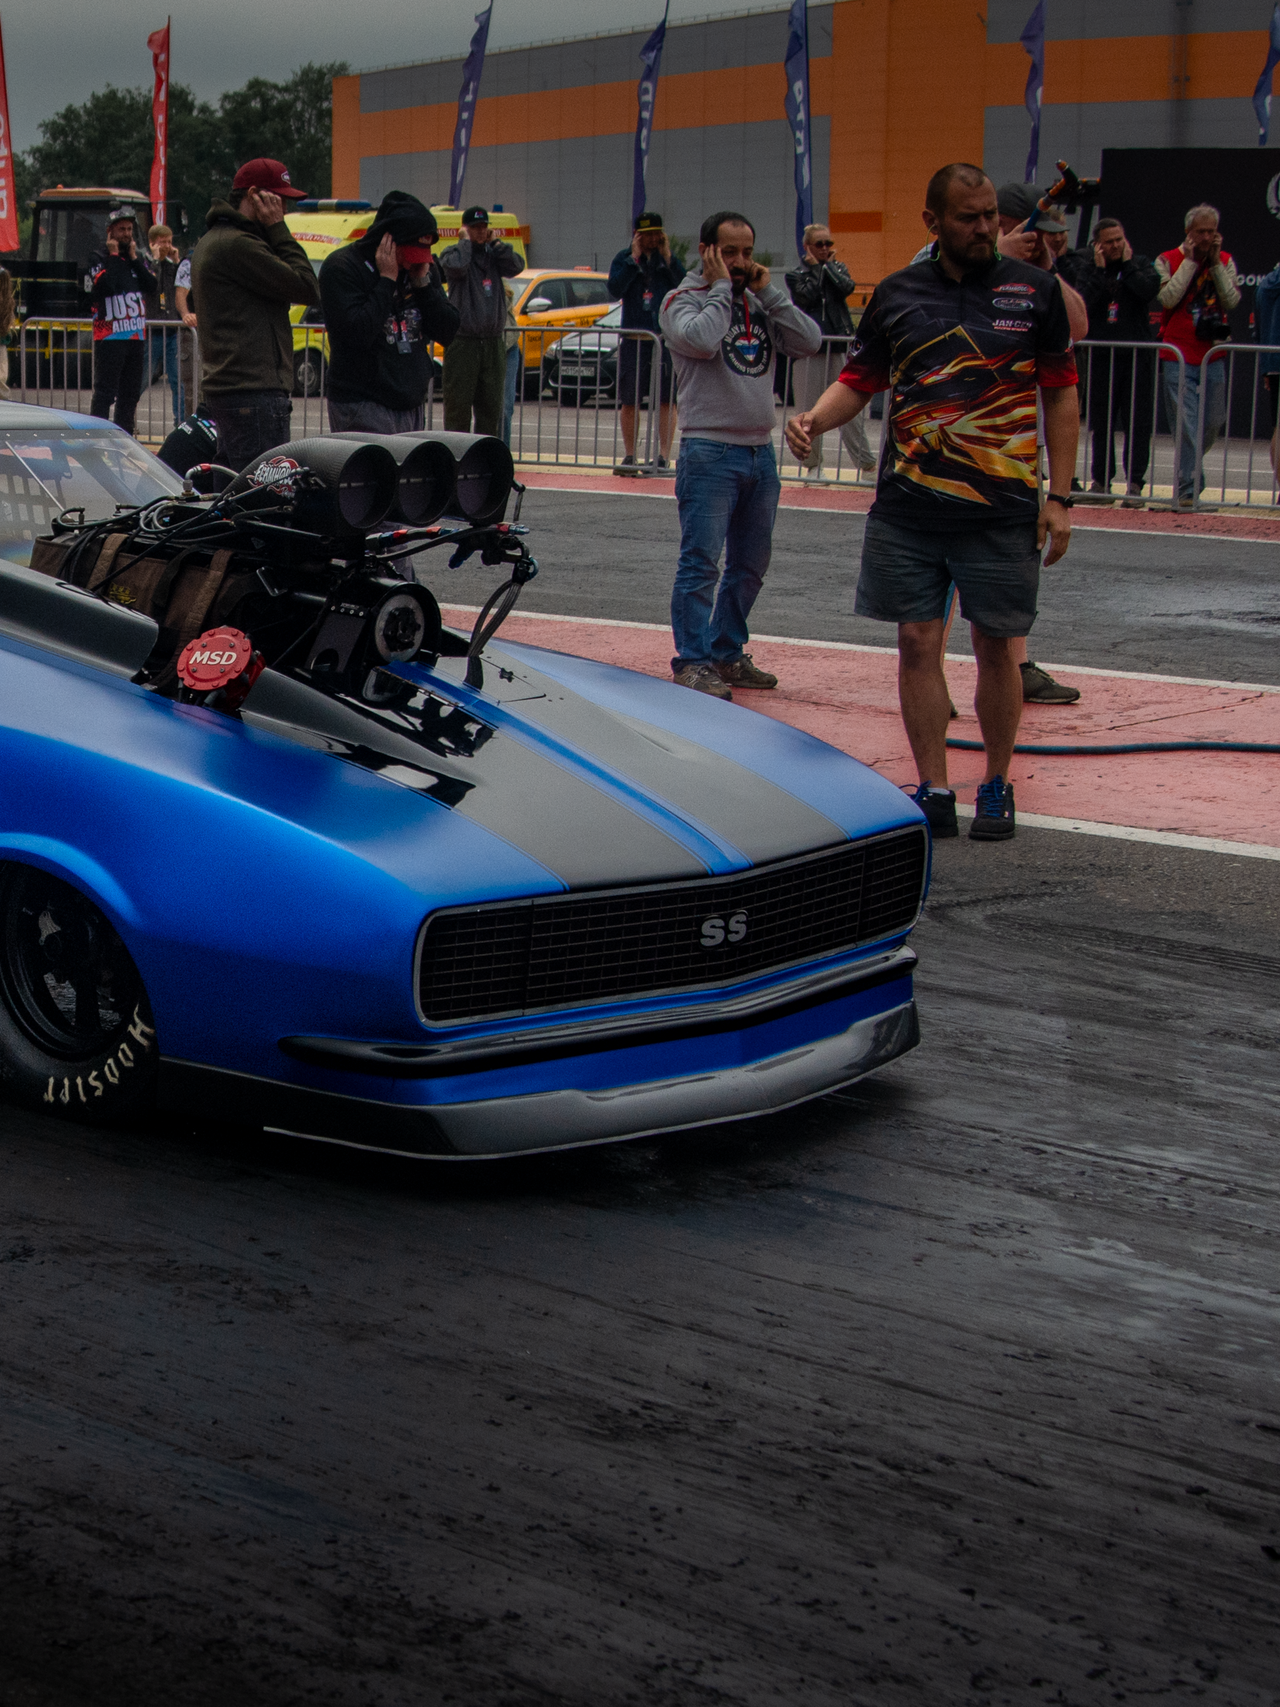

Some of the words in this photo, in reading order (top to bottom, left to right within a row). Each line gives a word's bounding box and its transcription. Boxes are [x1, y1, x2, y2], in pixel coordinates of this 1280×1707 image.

[105, 291, 145, 321] JUST
[189, 651, 237, 665] MSD
[700, 912, 748, 947] SS
